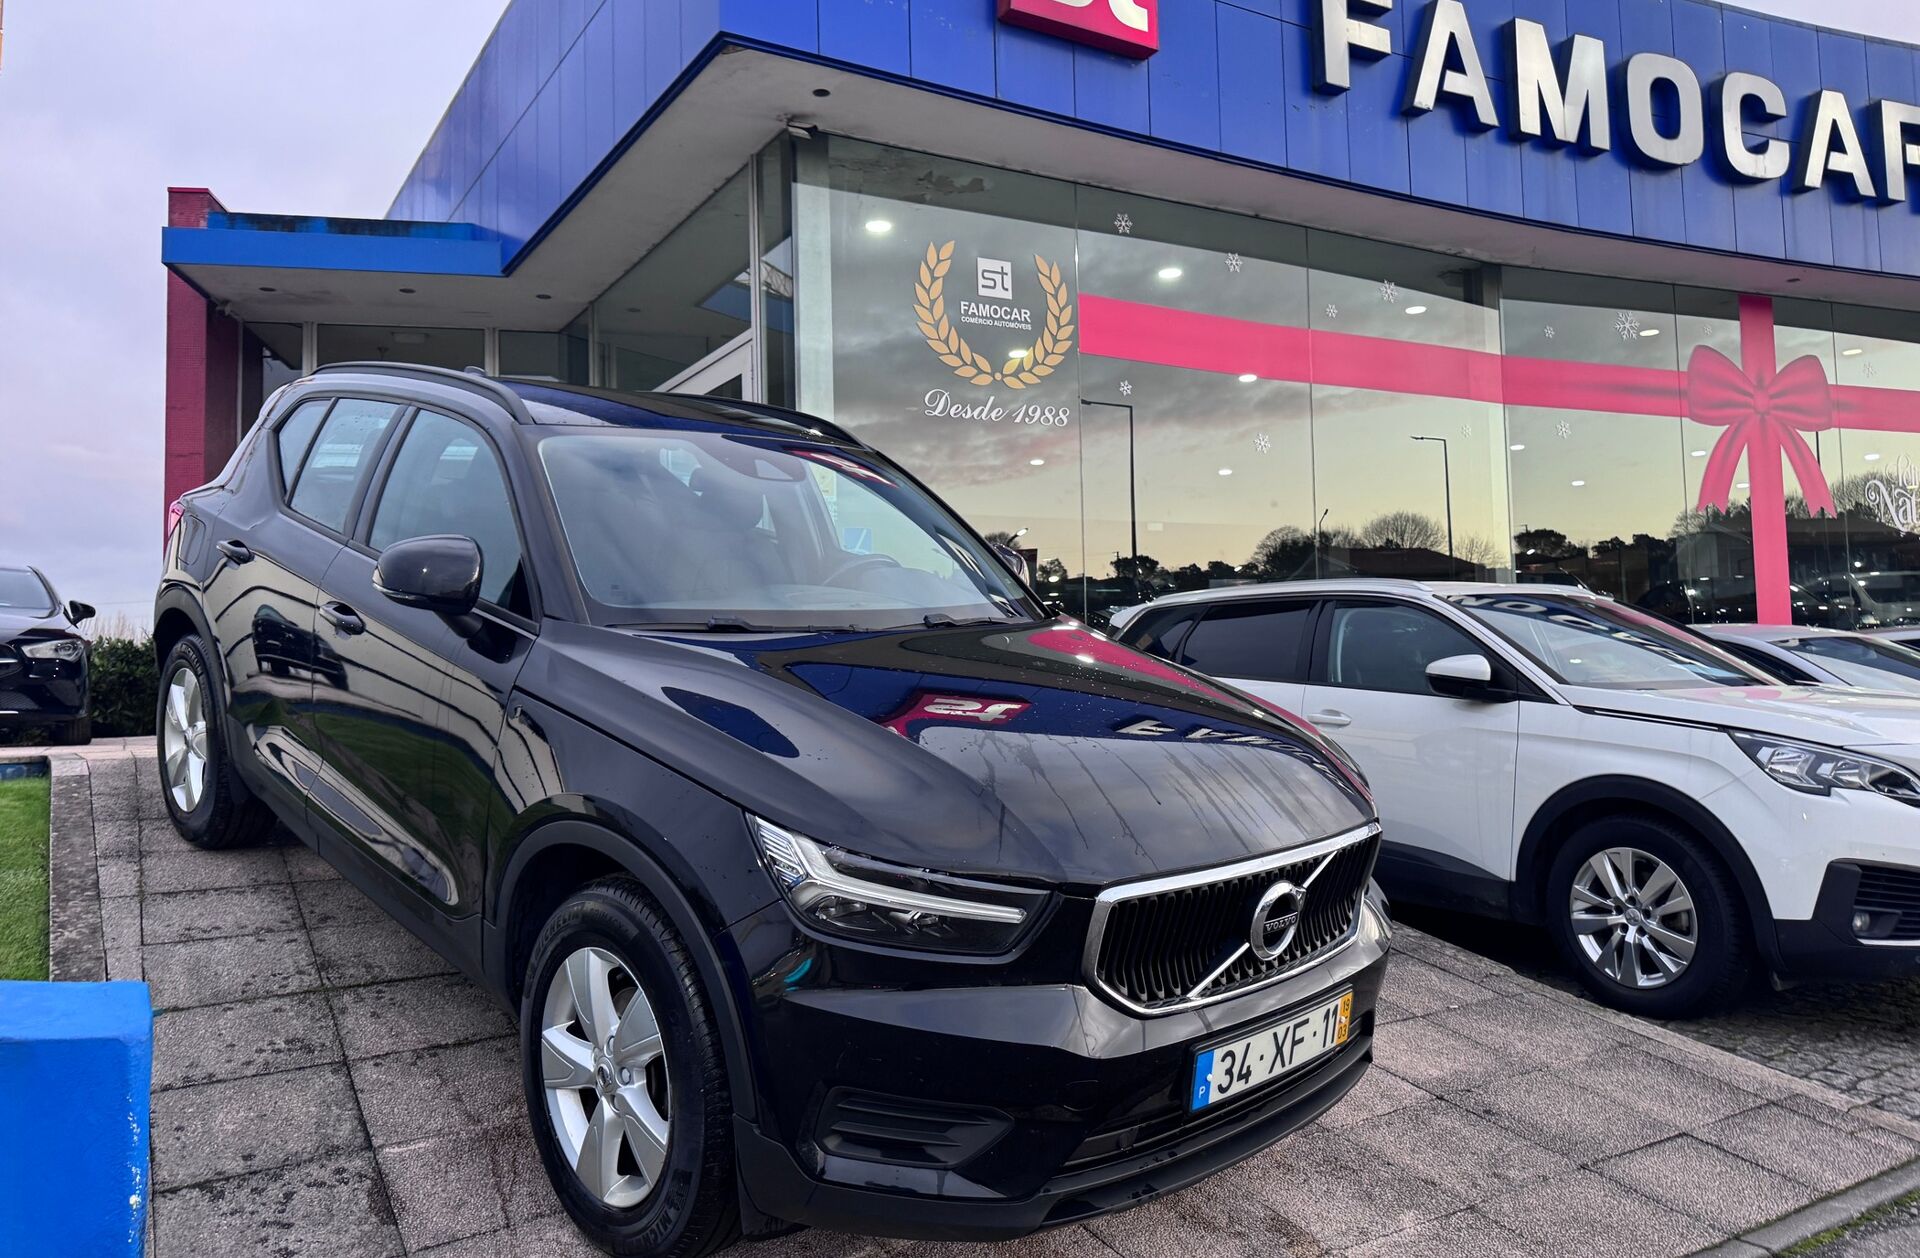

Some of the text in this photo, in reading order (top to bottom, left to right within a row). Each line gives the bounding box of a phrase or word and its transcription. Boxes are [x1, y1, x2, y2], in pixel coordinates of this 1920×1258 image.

[981, 266, 1009, 292] st
[960, 300, 1032, 323] FAMOCAR
[961, 315, 1032, 331] COMÉRCIO AUTOMÓVEIS
[923, 388, 1070, 427] Desde 1988
[1265, 915, 1297, 932] VOLVO
[1198, 1085, 1206, 1099] P
